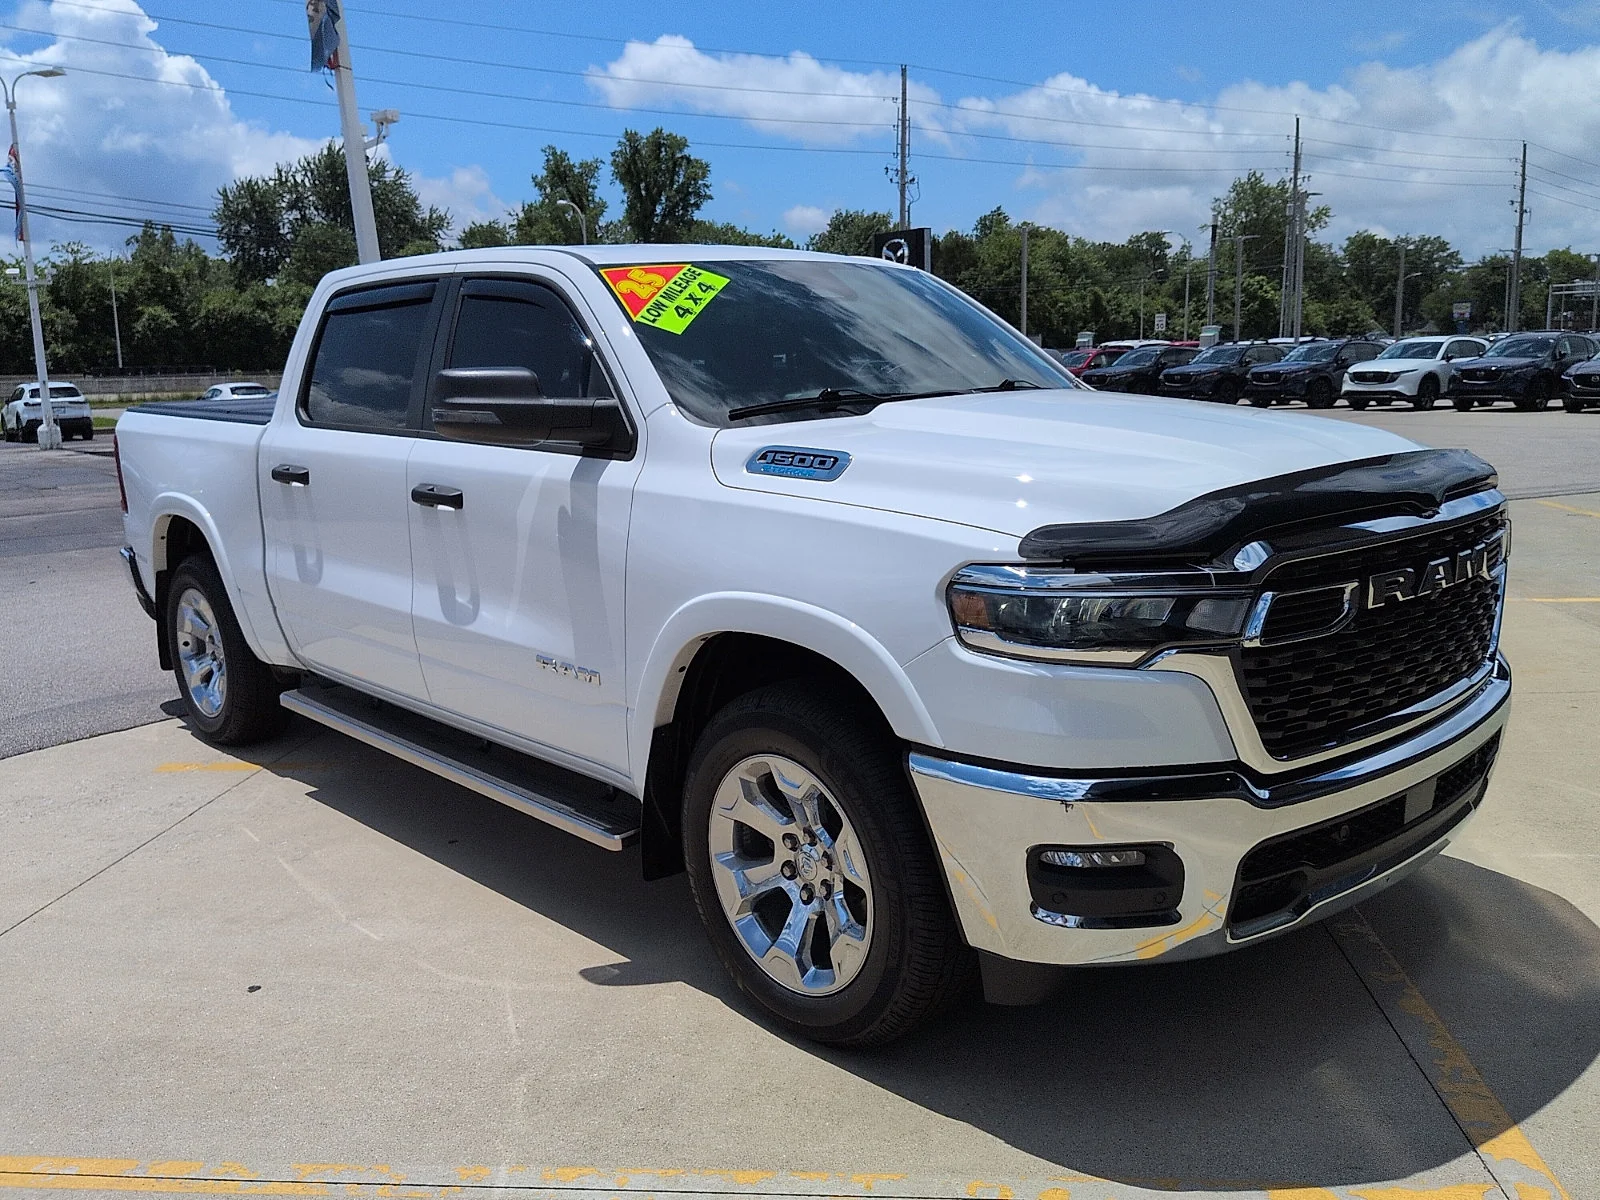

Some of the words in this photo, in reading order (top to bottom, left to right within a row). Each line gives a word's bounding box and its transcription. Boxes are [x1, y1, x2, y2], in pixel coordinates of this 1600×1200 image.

[616, 268, 666, 299] 25
[641, 298, 668, 324] LOW
[660, 267, 702, 303] MILEAGE
[757, 452, 835, 469] 1500
[1368, 542, 1492, 609] RAM
[536, 654, 601, 686] RAM
